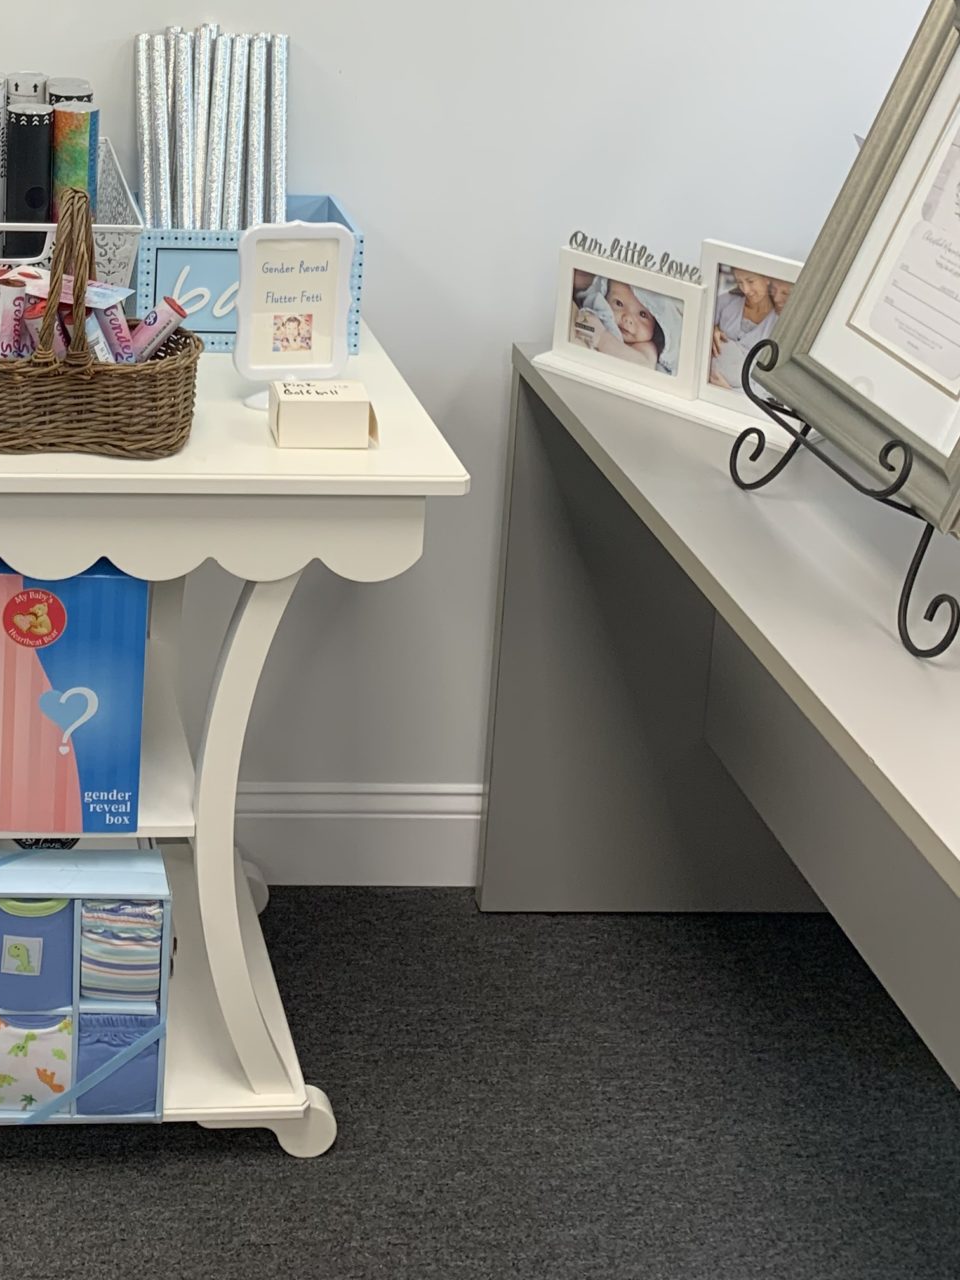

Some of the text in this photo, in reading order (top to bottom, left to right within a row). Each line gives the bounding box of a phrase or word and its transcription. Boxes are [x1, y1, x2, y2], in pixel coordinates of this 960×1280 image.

[569, 230, 607, 256] Our
[608, 237, 657, 269] little
[262, 259, 329, 274] Gender Reveal
[265, 289, 322, 304] Flutter Fetti
[14, 593, 28, 604] My
[8, 628, 58, 646] Heartbeat Bear
[84, 789, 132, 803] gender
[90, 801, 131, 813] reveal
[105, 813, 130, 824] box
